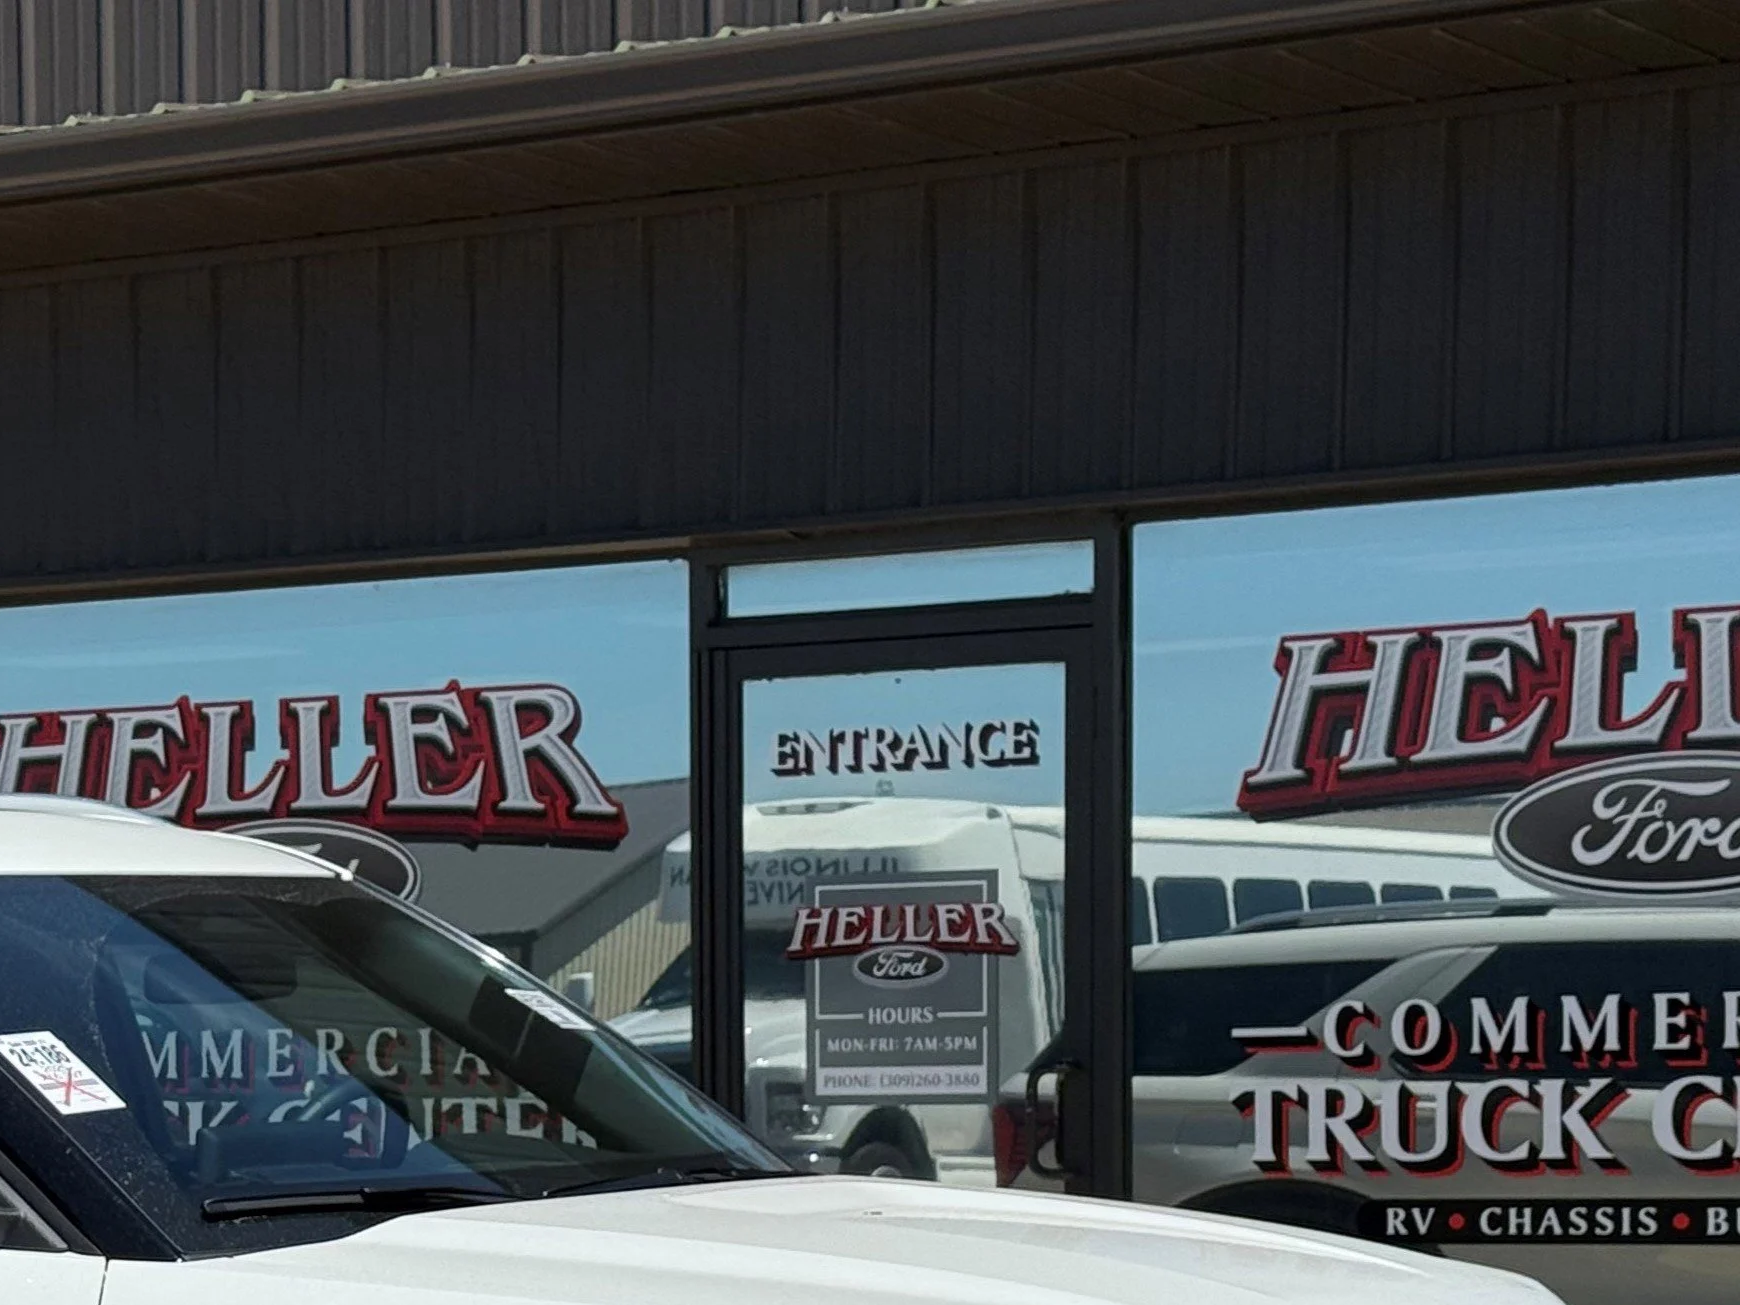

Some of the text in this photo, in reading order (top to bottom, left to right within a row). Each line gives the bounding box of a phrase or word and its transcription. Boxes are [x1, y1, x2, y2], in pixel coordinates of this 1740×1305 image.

[771, 719, 1041, 776] ENTRANCE
[786, 902, 1020, 958] HELLER
[872, 951, 927, 977] Ford
[868, 1007, 934, 1025] HOURS
[826, 1035, 978, 1053] MON-FRI: 7AM-5PM
[1228, 1075, 1740, 1178] TRUCK C
[1386, 1207, 1436, 1236] RV
[1479, 1204, 1658, 1237] CHASSIS
